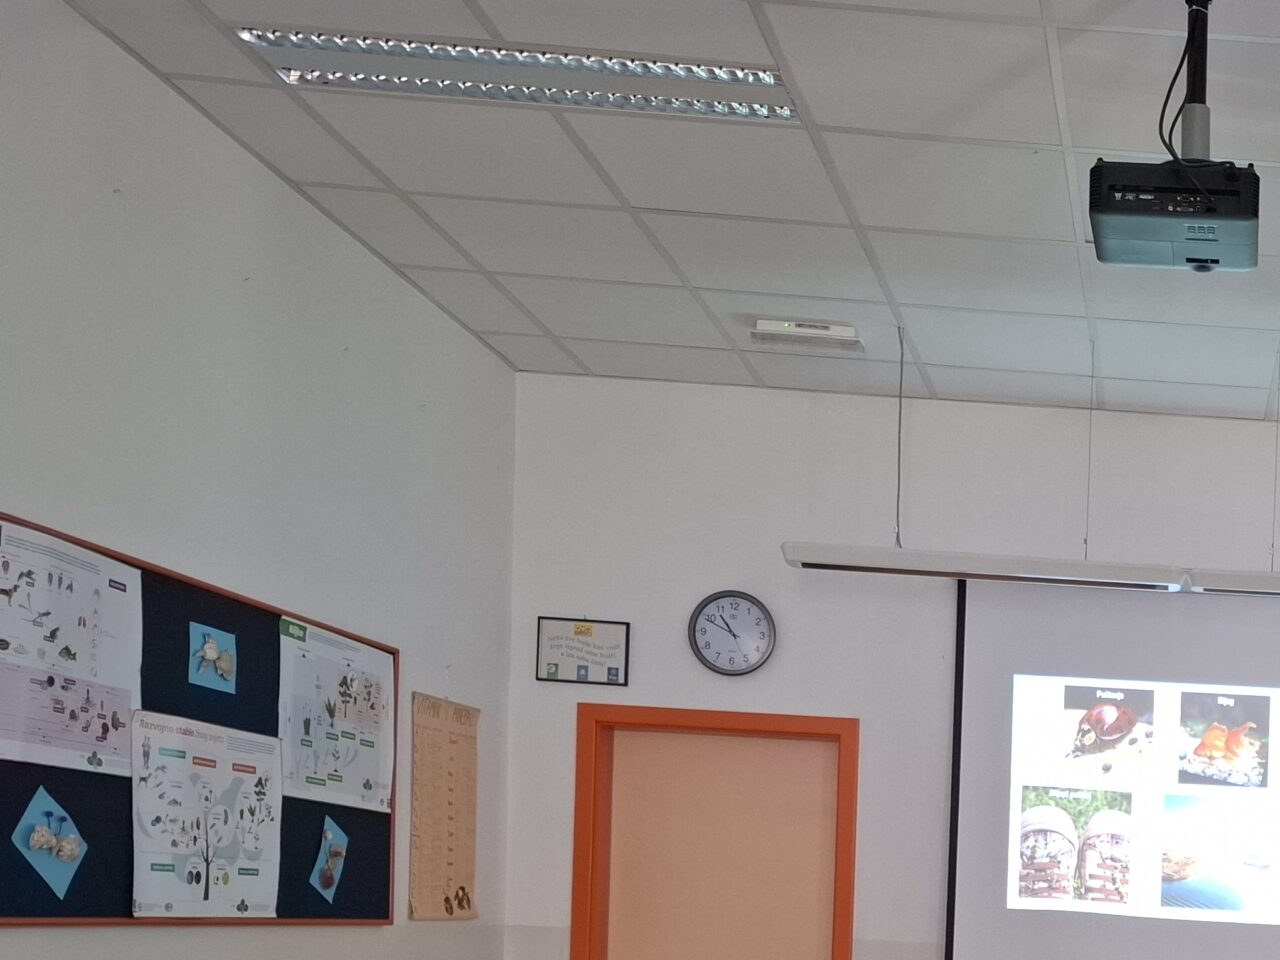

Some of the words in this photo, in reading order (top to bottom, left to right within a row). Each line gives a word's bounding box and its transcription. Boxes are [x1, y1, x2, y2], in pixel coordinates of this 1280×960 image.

[716, 605, 725, 614] 11
[729, 601, 740, 611] 12
[706, 613, 716, 622] 10
[755, 617, 762, 626] 2
[700, 627, 707, 636] 9
[759, 631, 766, 640] 3
[704, 641, 711, 650] 8
[754, 645, 760, 653] 4
[715, 651, 721, 660] 7
[743, 654, 750, 663] 5
[728, 656, 735, 666] 6
